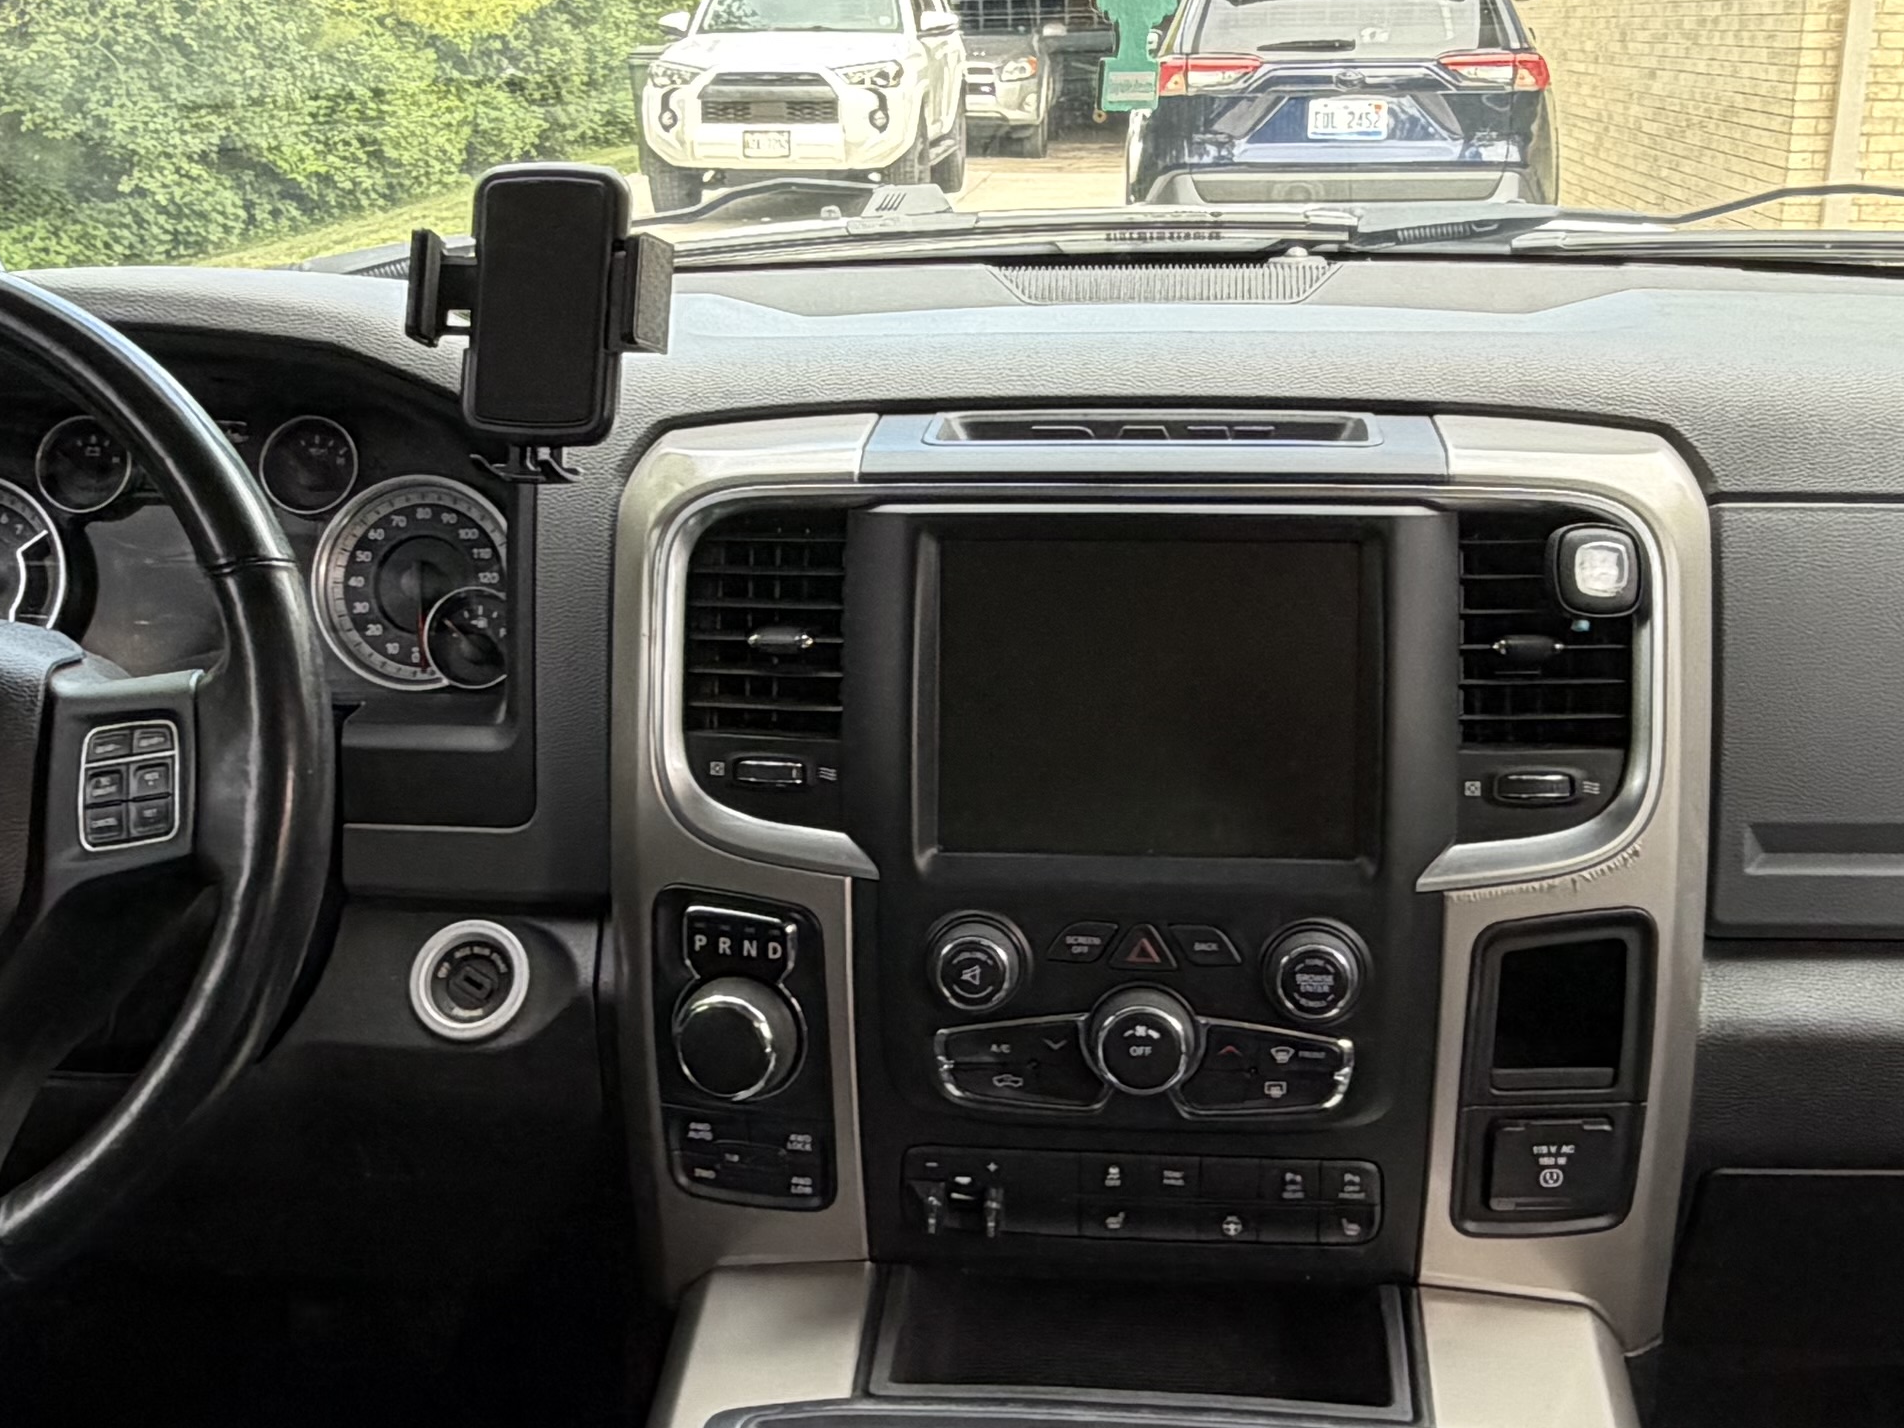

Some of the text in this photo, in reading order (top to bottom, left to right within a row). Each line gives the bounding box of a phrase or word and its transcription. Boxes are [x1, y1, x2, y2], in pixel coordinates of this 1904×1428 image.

[415, 507, 433, 519] 80
[440, 512, 459, 524] 90
[389, 514, 407, 527] 70
[367, 528, 386, 540] 60
[458, 528, 480, 540] 100
[355, 550, 373, 563] 50
[472, 547, 493, 559] 110
[348, 576, 366, 588] 40
[478, 571, 500, 584] 120
[352, 601, 370, 614] 30
[365, 623, 383, 636] 20
[385, 642, 400, 655] 10
[1066, 936, 1102, 945] SCREEN
[1193, 942, 1218, 951] BACK
[694, 935, 782, 959] P R N D
[1071, 946, 1089, 954] OFF
[1295, 974, 1334, 984] BROWSE
[1300, 984, 1329, 993] ENTER
[990, 1043, 1011, 1054] A/C
[1129, 1046, 1152, 1056] OFF
[786, 1142, 813, 1152] LOCK
[1561, 1144, 1576, 1154] AC
[790, 1185, 813, 1195] LOW
